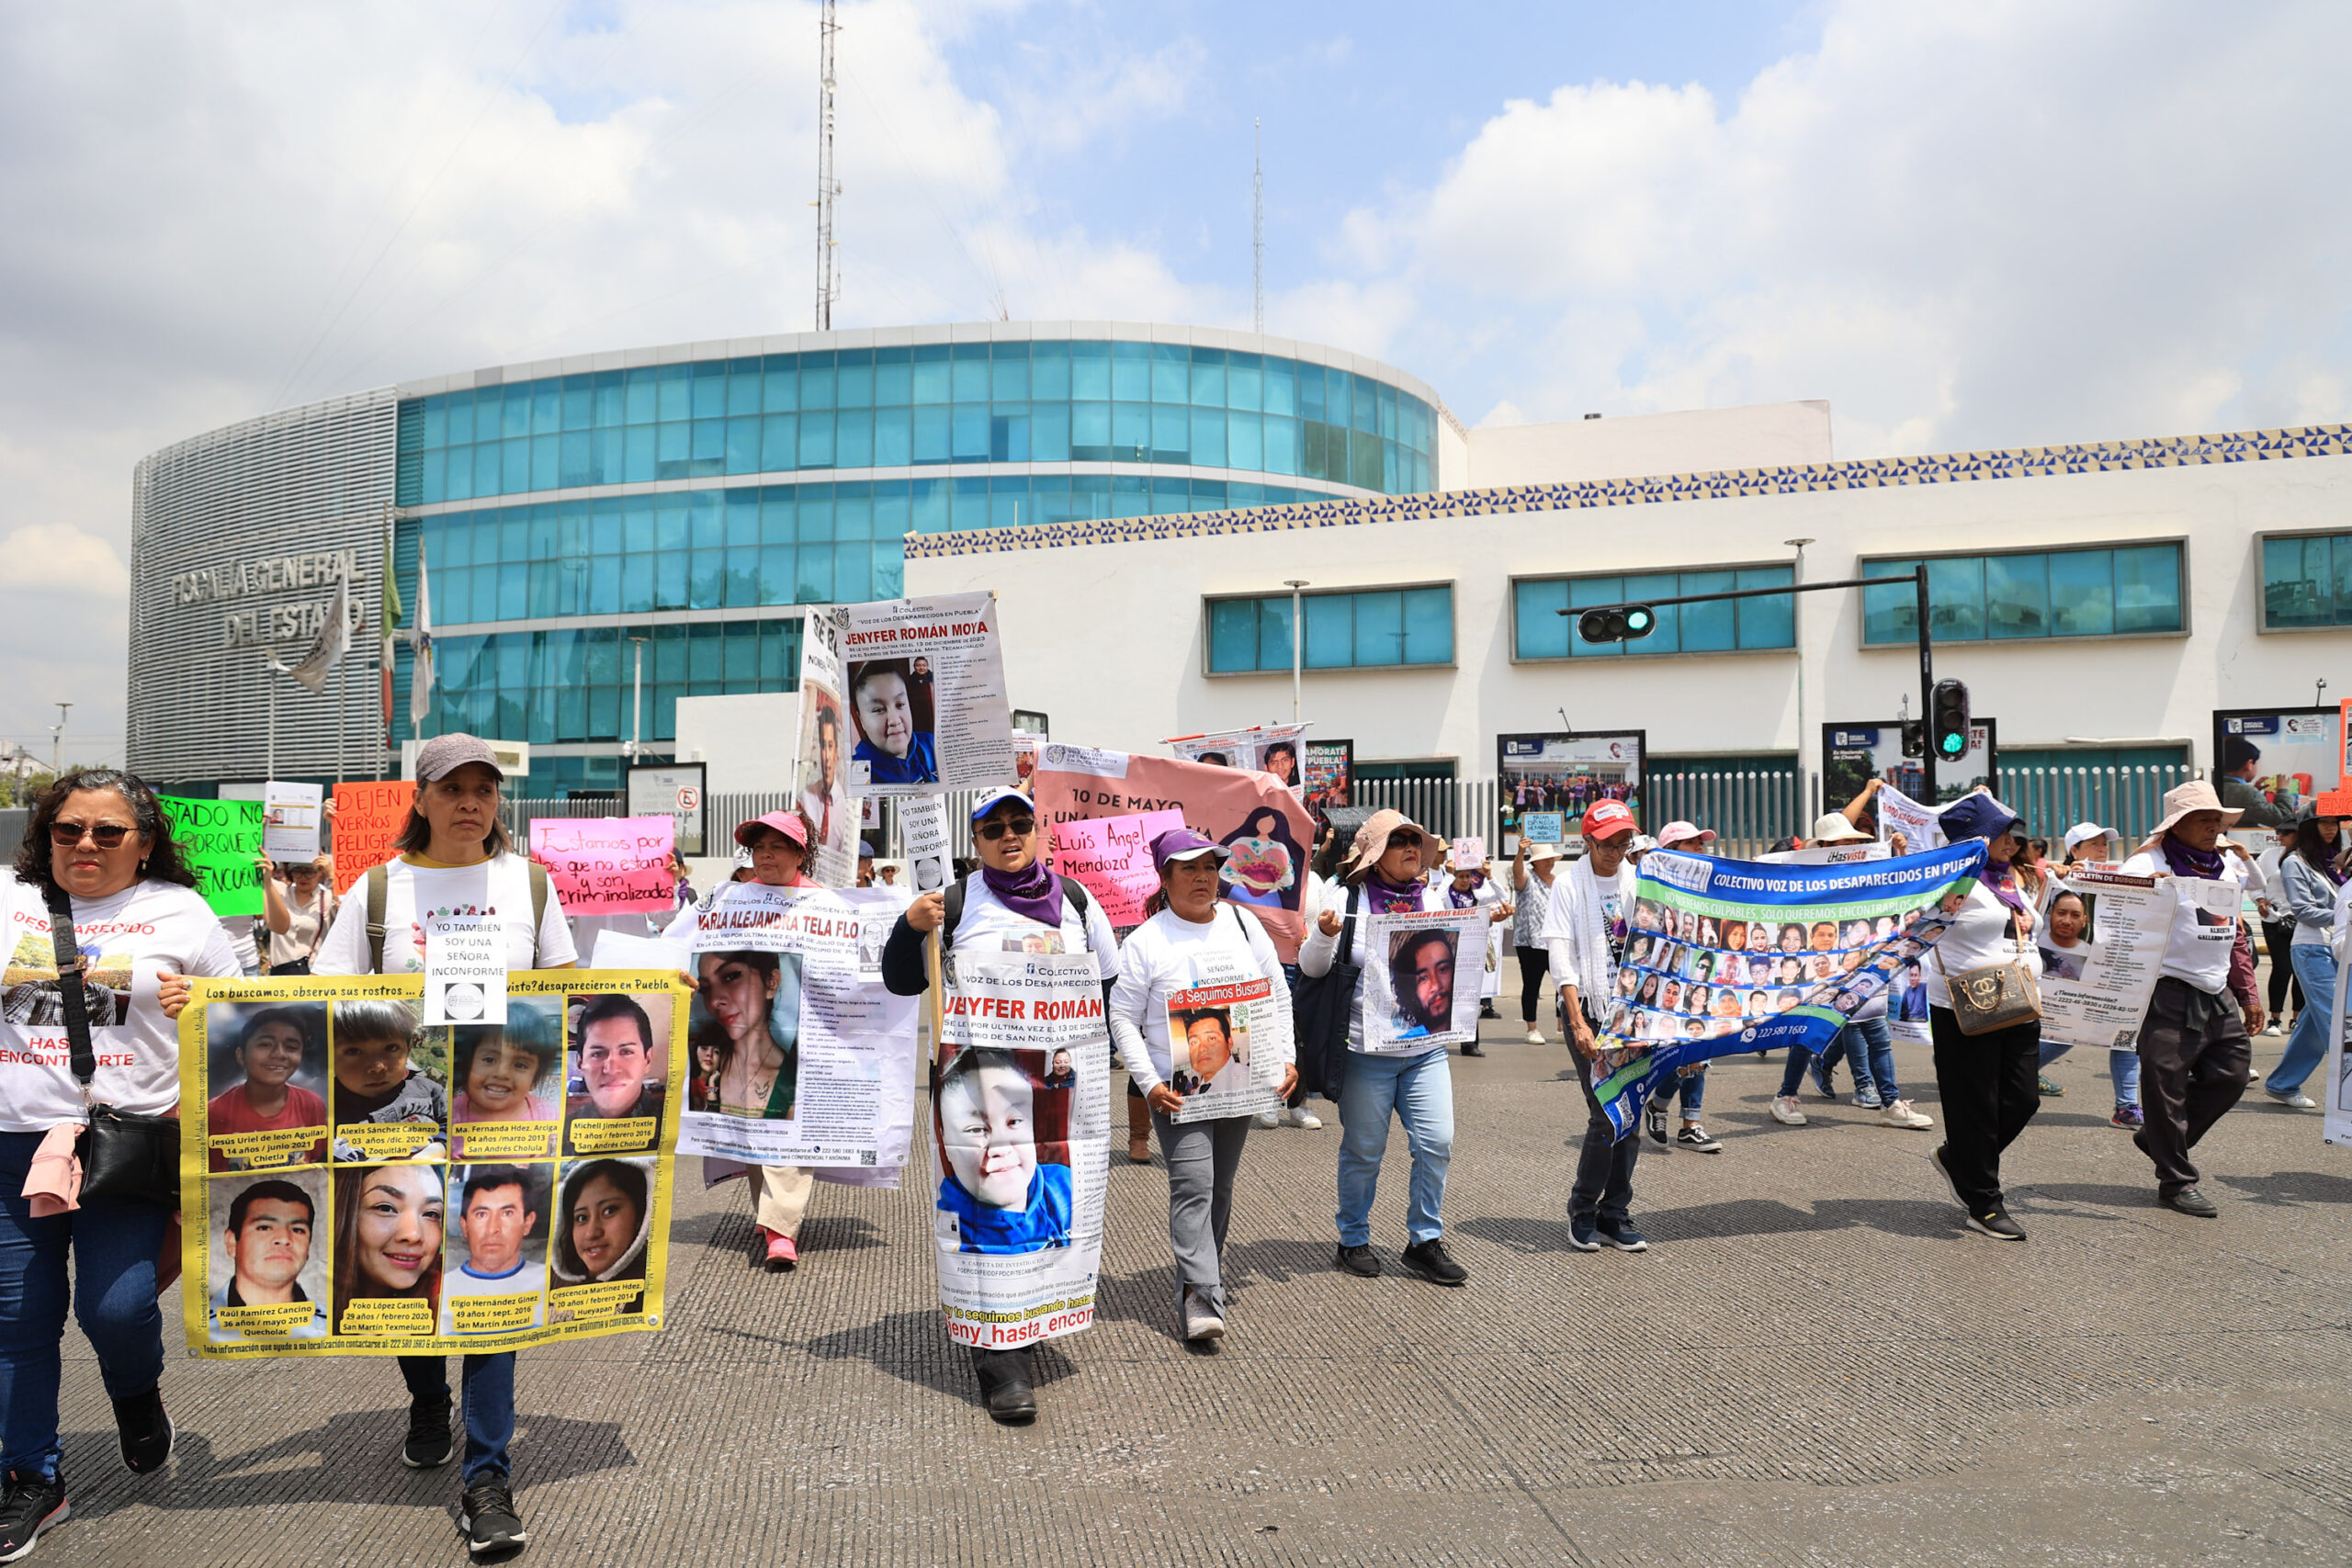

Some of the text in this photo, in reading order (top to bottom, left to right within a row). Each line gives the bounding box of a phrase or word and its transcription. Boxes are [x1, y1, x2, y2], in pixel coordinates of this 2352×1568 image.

[253, 548, 366, 590] GENERAL
[224, 598, 364, 645] DEL ESTAO
[845, 622, 988, 645] JENYFER ROMÁN MOYA
[336, 789, 401, 817] DEJEN
[1073, 789, 1090, 803] 10
[1098, 793, 1121, 807] DE
[910, 802, 942, 814] TAMBIÉN
[910, 817, 938, 829] SOY UNA
[540, 828, 664, 853] Estamos por
[911, 829, 939, 840] SEÑORA
[1058, 831, 1095, 851] Luis
[1108, 819, 1145, 858] Angel
[907, 839, 948, 854] INCONFORME
[538, 855, 561, 872] los
[568, 861, 590, 878] que
[595, 861, 613, 870] no
[1063, 855, 1129, 875] Mendoza
[1713, 864, 1939, 892] COLECTIVO VOZ DE LOS DESAPARECIDOS EN
[2114, 875, 2153, 886] BÚSQUEDA
[581, 876, 624, 897] y son
[558, 883, 673, 905] criminalizados
[1665, 892, 1674, 902] NO
[1711, 903, 1758, 919] CULPABLES,
[1760, 908, 1783, 919] SOLO
[1785, 908, 1836, 919] QUEREMOS
[436, 922, 501, 931] YO TAMBIÉN
[729, 910, 797, 931] ALEJANDRA
[803, 916, 831, 936] TELA
[446, 938, 465, 946] SOY
[447, 951, 490, 961] SEÑORA
[433, 967, 504, 976] INCONFORME
[636, 979, 669, 989] Puebla
[1025, 979, 1100, 987] DESAPARECIDOS
[206, 987, 401, 998] Los buscamos, observa sus rostros
[1186, 987, 1233, 1003] Seguimos
[1236, 979, 1269, 997] Buscando
[1034, 995, 1102, 1021] ROMÁN
[991, 1021, 1023, 1032] ÚLTIMA
[1758, 1029, 1771, 1038] 222
[341, 1126, 365, 1134] Alexis
[368, 1125, 398, 1134] Sánchez
[534, 1124, 558, 1133] Arciga
[574, 1120, 653, 1130] Michell Jiménez Toxtle
[211, 1137, 235, 1146] Jesús
[237, 1135, 258, 1145] Uriel
[261, 1134, 272, 1142] de
[294, 1129, 324, 1140] Aguilar
[352, 1137, 361, 1145] 03
[368, 1146, 407, 1156] Zoquitlán
[485, 1144, 510, 1152] Andrés
[254, 1153, 284, 1163] Chietla
[552, 1282, 641, 1300] Crescencia Martínez Hdez.
[376, 1301, 395, 1311] López
[451, 1294, 538, 1309] Eligio Hernández Ginez
[220, 1304, 312, 1317] Raúl Ramírez Cancino
[578, 1305, 612, 1317] Hueyapan
[954, 1306, 963, 1318] te
[966, 1310, 1022, 1324] seguimos
[1068, 1295, 1091, 1309] hasta
[457, 1316, 529, 1329] San Martín Atexcal
